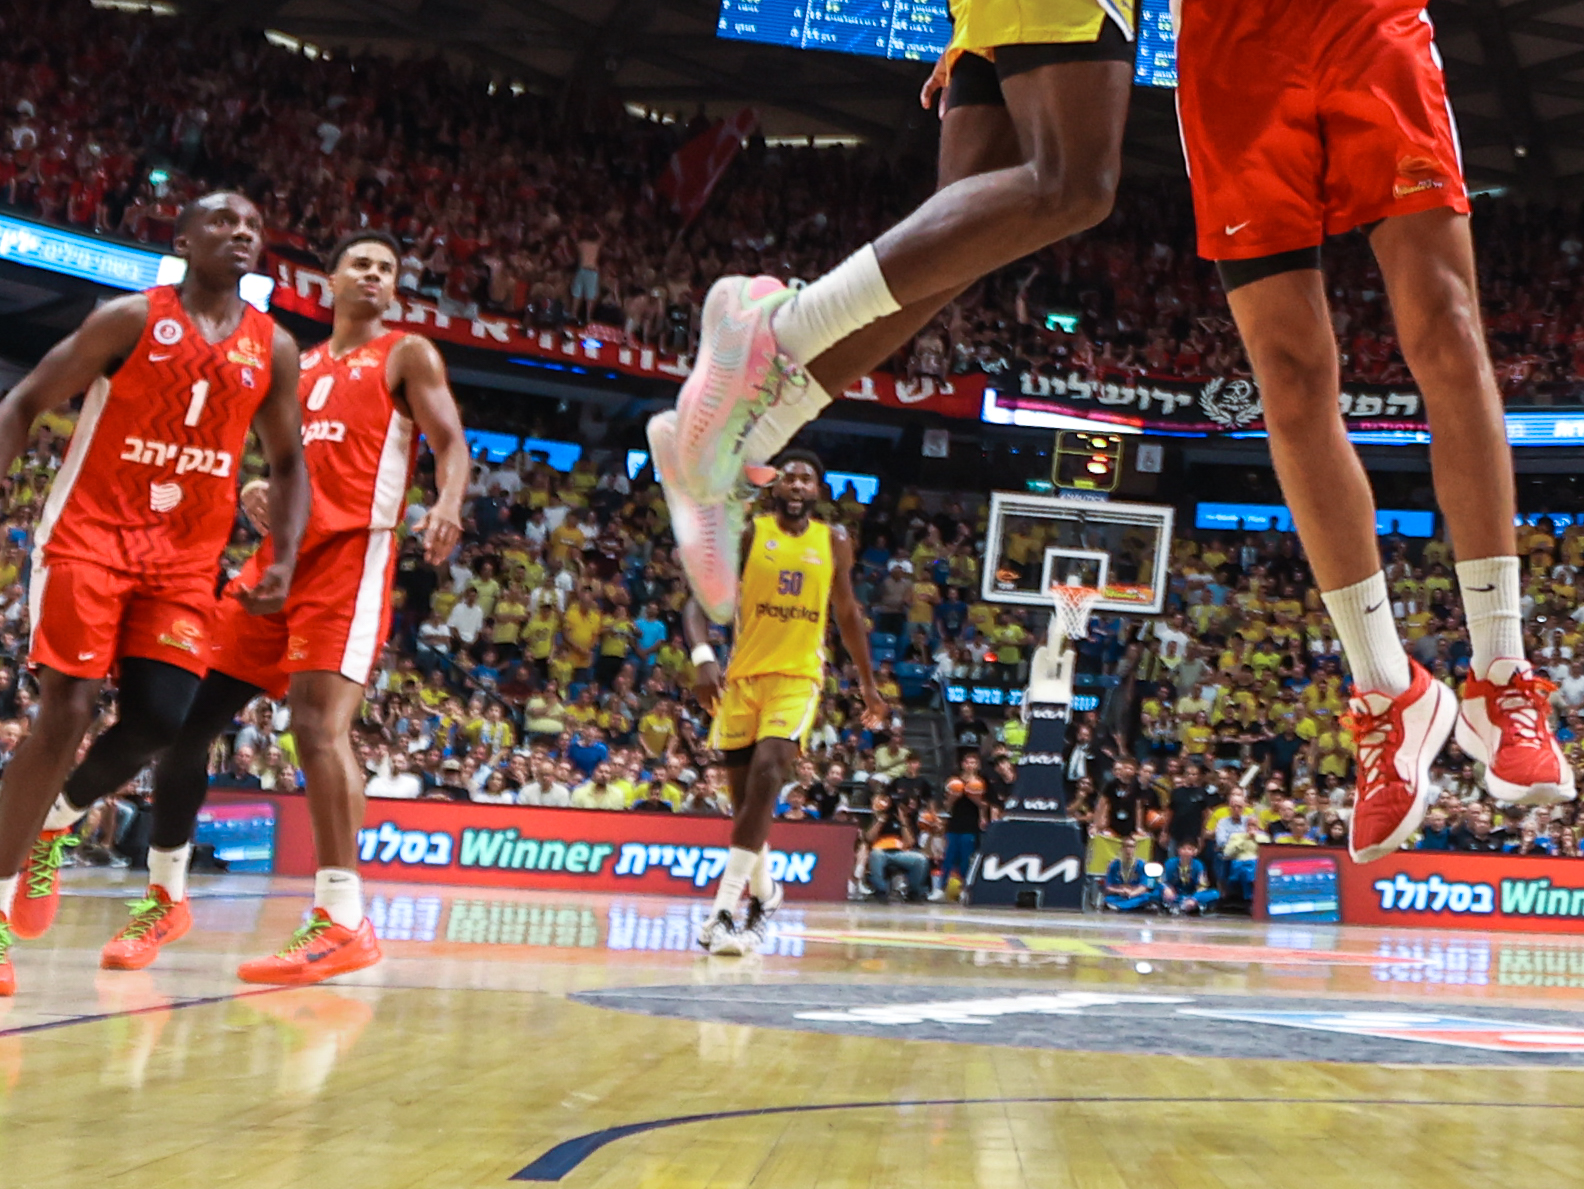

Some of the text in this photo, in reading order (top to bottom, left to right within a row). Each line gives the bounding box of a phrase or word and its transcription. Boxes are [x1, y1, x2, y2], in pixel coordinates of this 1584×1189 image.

[184, 378, 210, 428] 1
[306, 374, 335, 412] 0
[777, 569, 804, 596] 50
[358, 822, 816, 887] בסלו Winner אפקציית
[982, 855, 1080, 883] KIA
[1374, 873, 1495, 914] בסלולר
